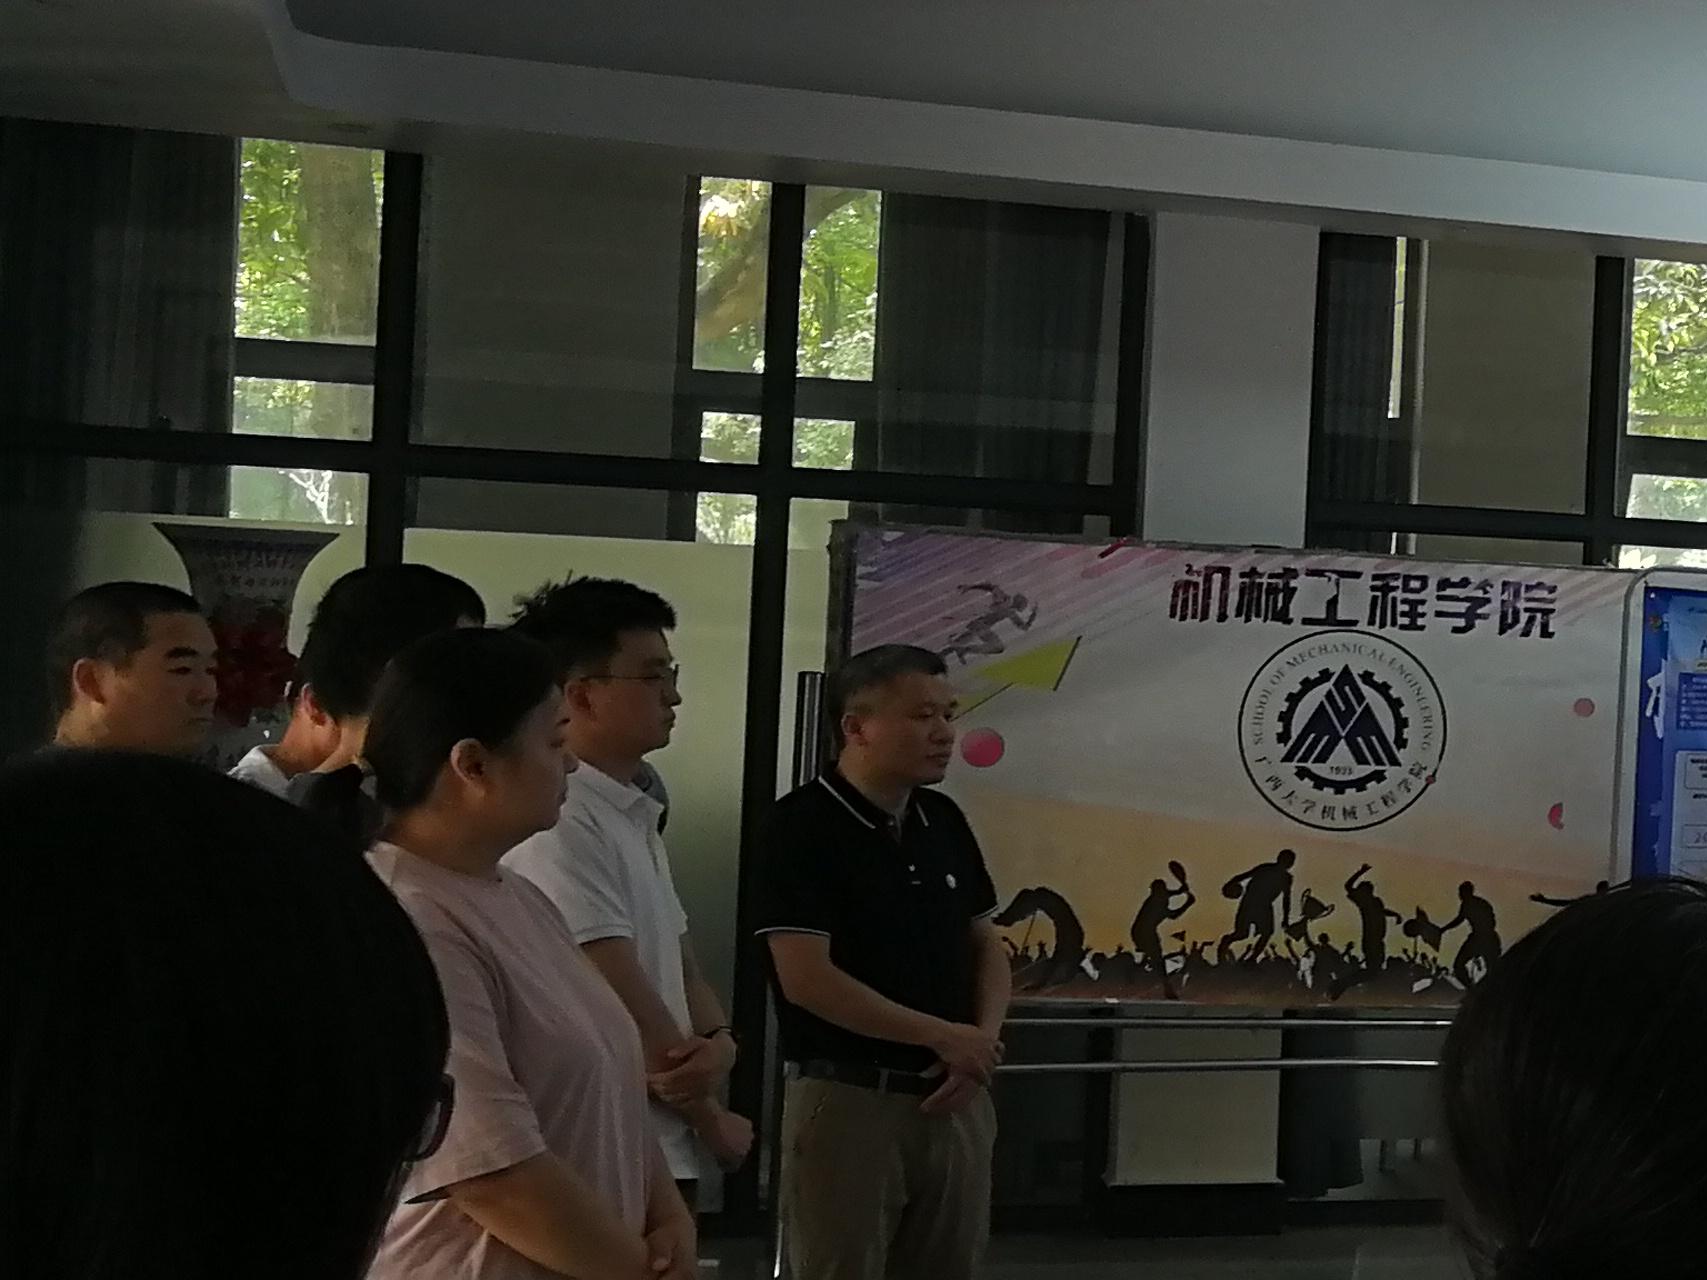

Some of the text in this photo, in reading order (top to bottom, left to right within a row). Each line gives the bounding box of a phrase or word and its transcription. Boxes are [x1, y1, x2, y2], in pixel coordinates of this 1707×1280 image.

[1168, 563, 1559, 639] 机械工程学院
